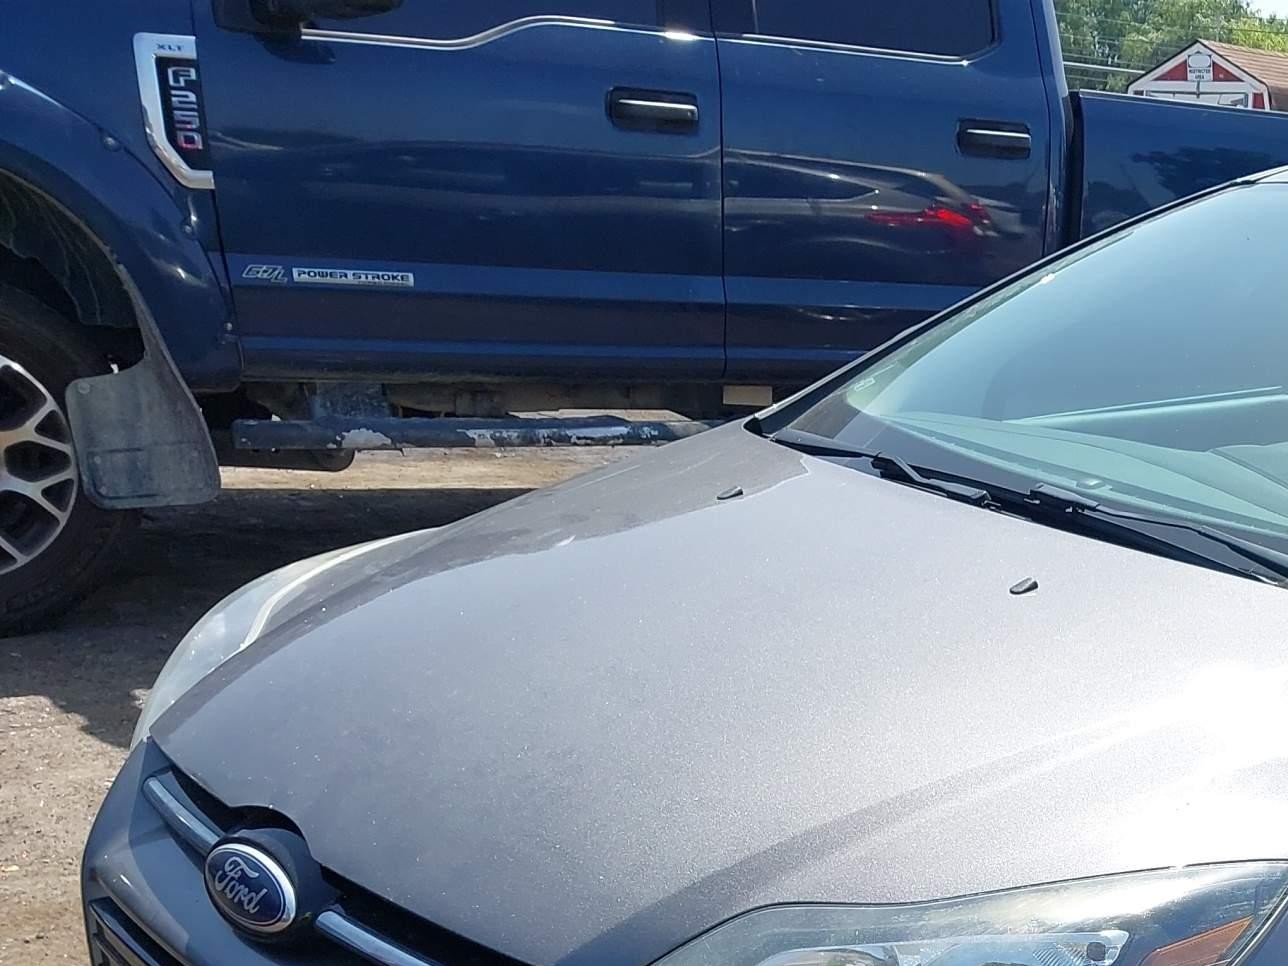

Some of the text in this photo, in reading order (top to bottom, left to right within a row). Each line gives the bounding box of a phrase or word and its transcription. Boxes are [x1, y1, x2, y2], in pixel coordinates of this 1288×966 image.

[167, 66, 203, 150] F250
[297, 270, 348, 280] POWER
[352, 272, 409, 282] STROKE
[215, 856, 268, 914] Ford
